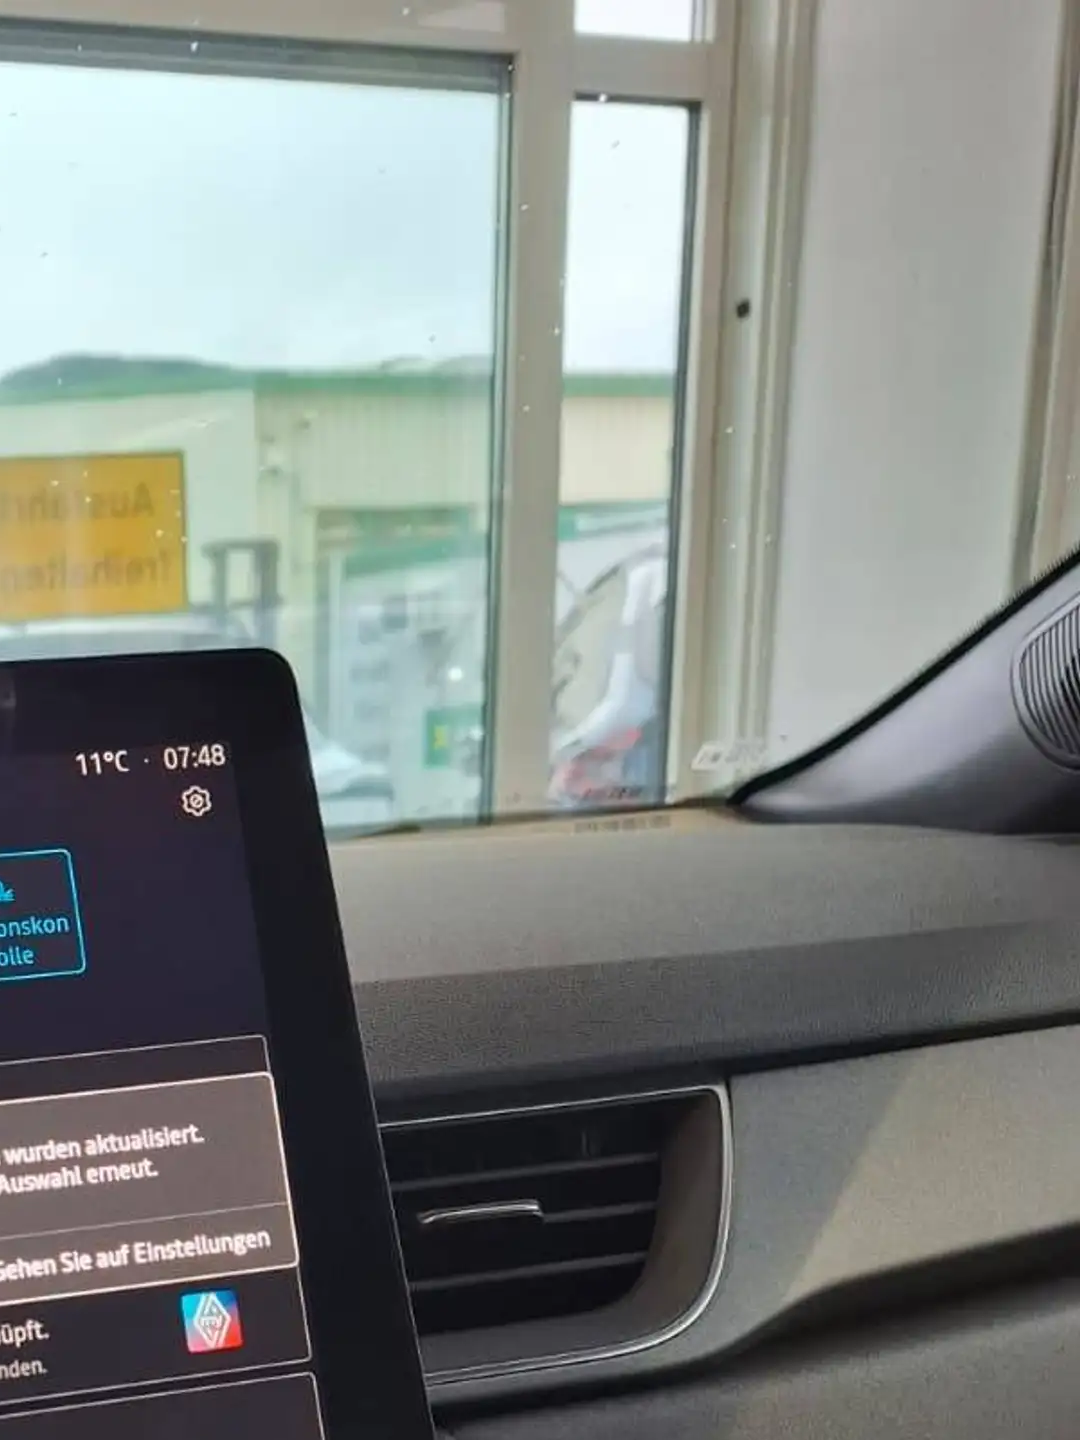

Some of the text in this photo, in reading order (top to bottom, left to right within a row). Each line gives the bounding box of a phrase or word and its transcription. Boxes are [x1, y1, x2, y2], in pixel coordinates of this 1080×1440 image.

[75, 743, 226, 776] 11°C 07:48
[4, 1140, 81, 1166] wurden
[84, 1123, 205, 1156] aktualisiert.
[86, 1158, 159, 1184] erneut.
[61, 1250, 93, 1273] Sie
[96, 1245, 130, 1269] auf
[134, 1230, 271, 1264] Einstellungen
